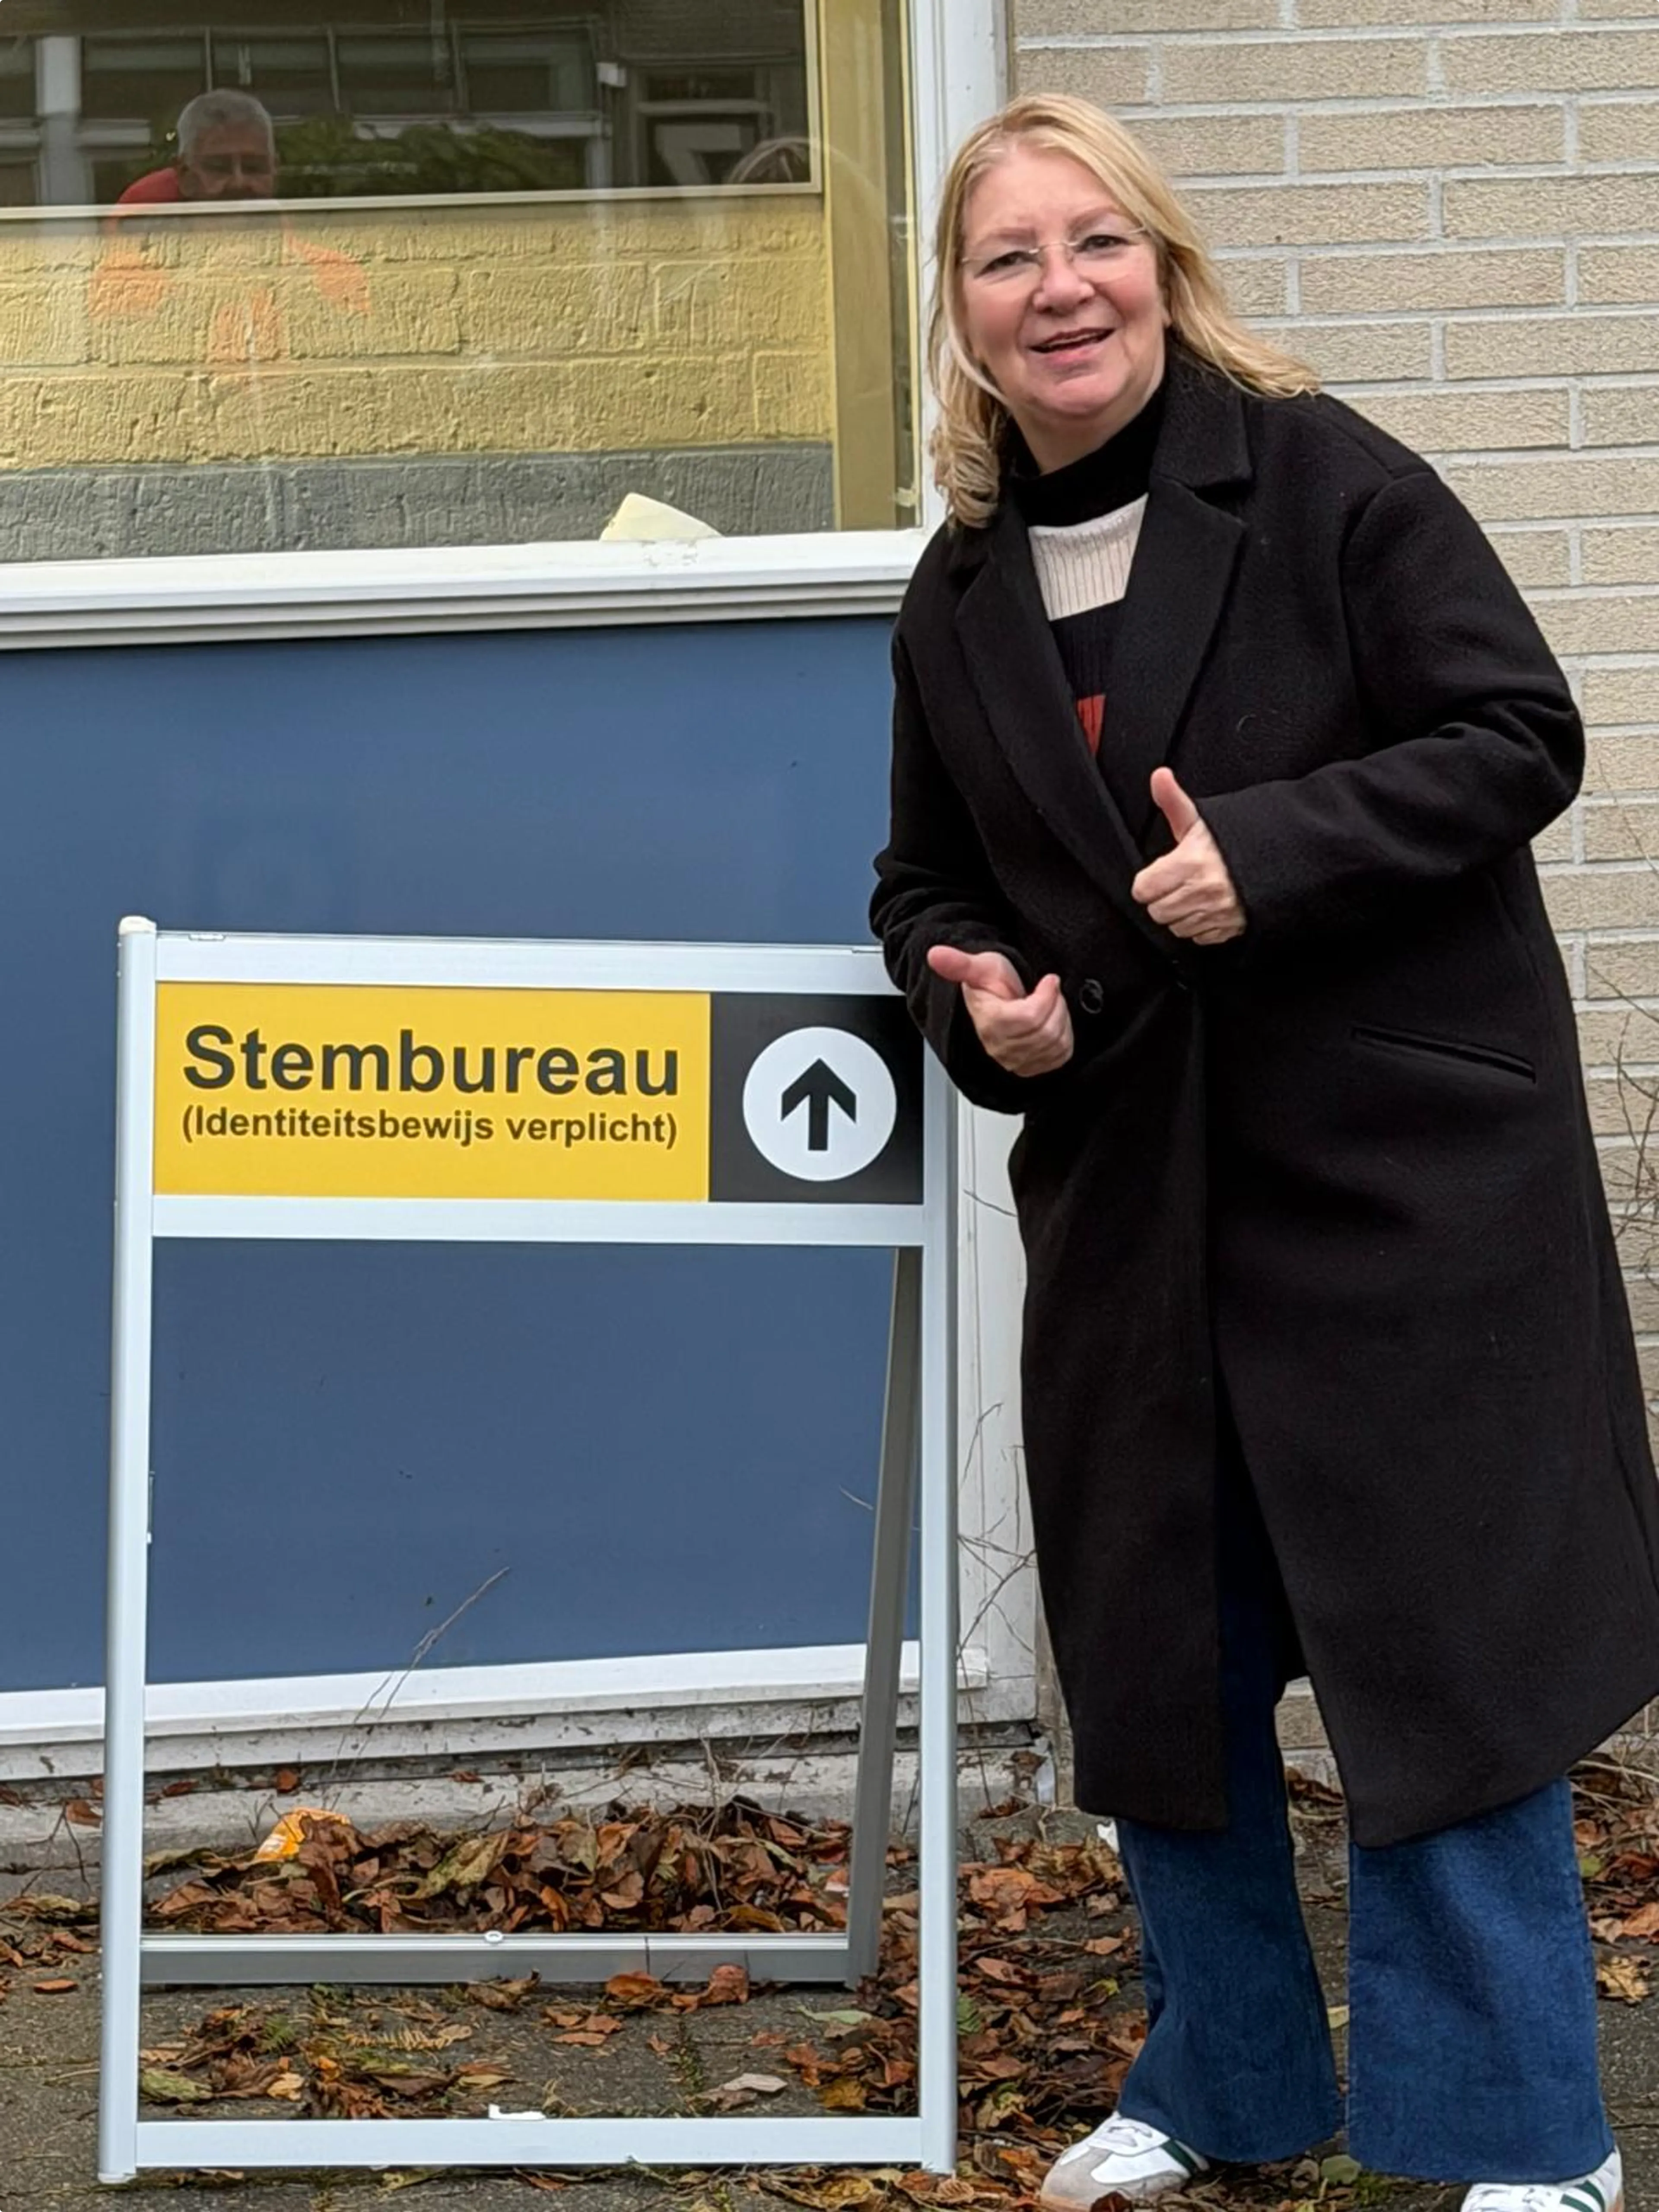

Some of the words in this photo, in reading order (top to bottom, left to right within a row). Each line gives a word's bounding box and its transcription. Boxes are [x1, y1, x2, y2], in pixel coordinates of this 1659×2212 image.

[183, 1025, 678, 1096] Stembureau
[183, 1106, 494, 1147] (Identiteitsbewijs
[506, 1112, 677, 1149] verplicht)
